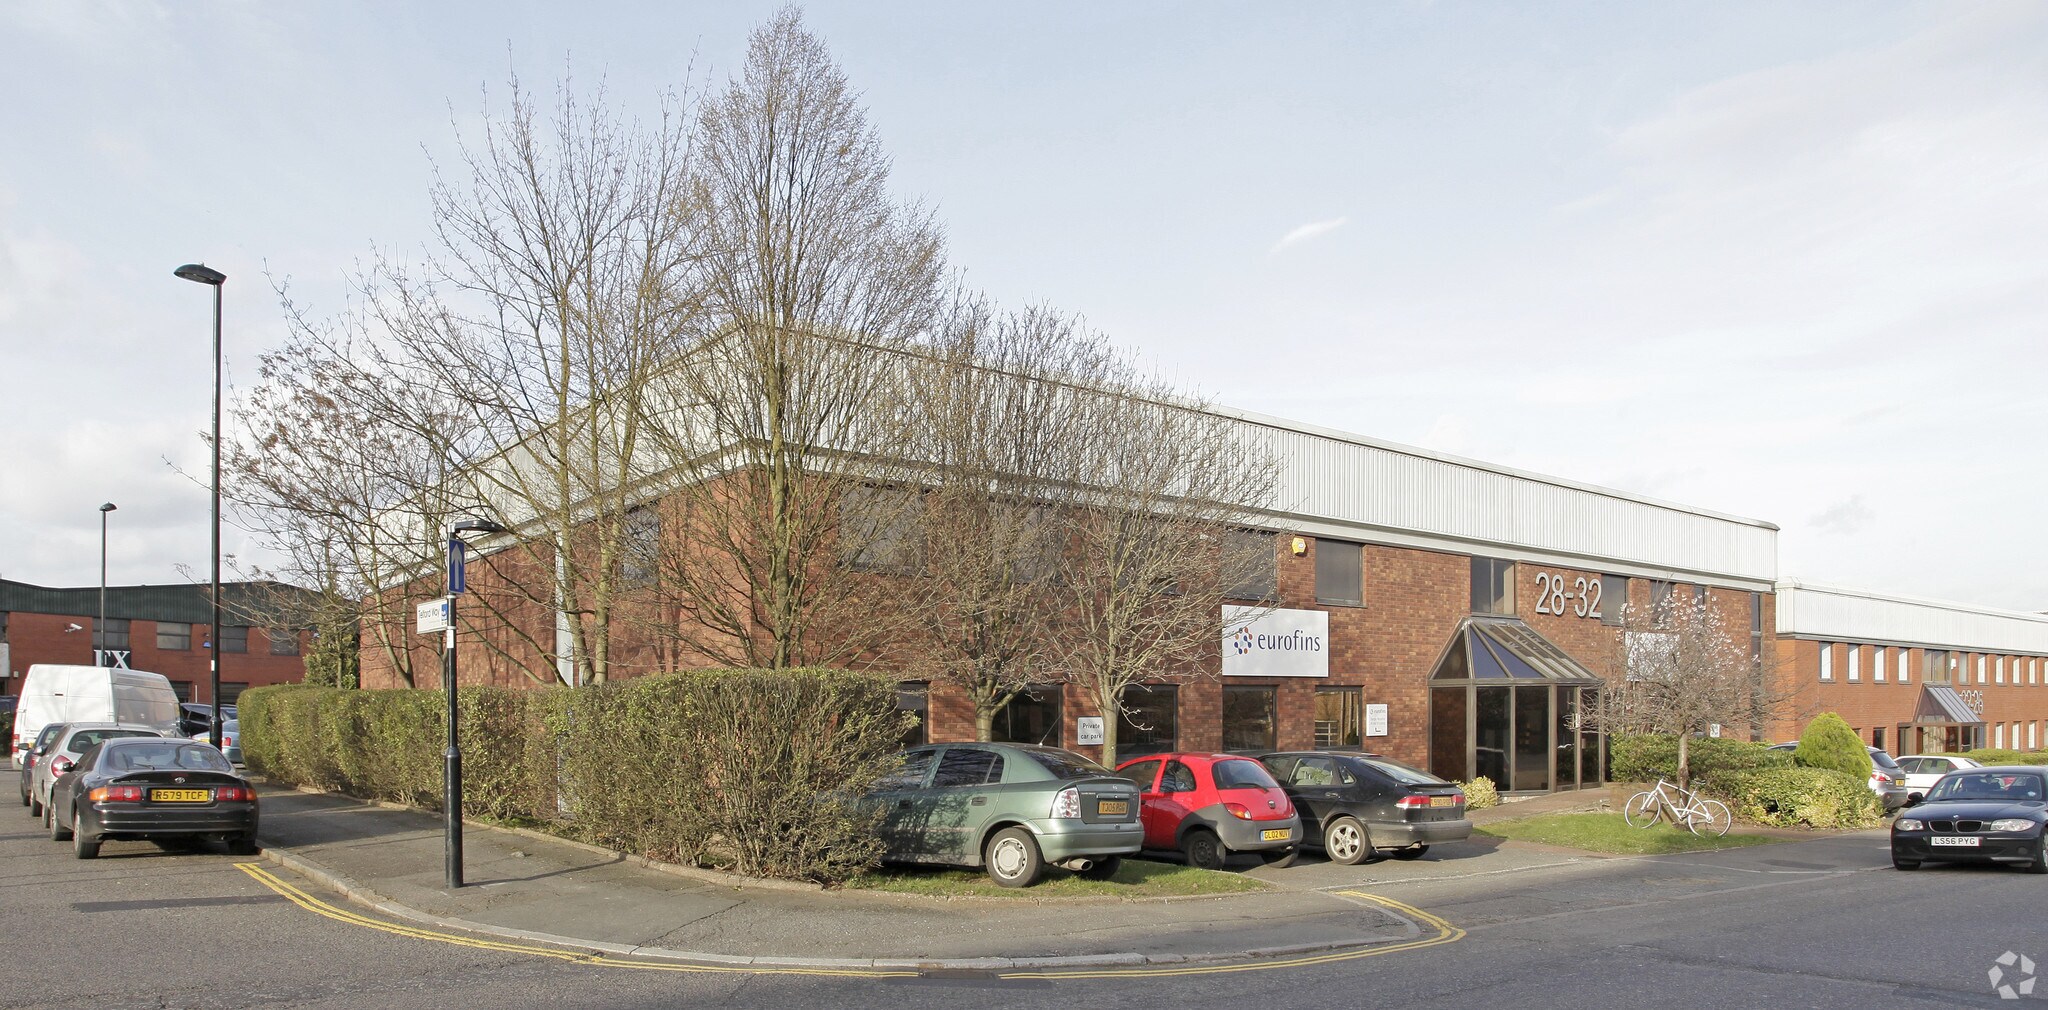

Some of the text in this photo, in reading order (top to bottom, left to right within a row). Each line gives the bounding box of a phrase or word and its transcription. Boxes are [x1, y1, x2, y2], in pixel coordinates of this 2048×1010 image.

[1535, 572, 1602, 617] 28-32
[1257, 629, 1321, 652] eurofins
[1090, 732, 1102, 740] park
[155, 791, 203, 800] R579 TCF
[1934, 837, 1975, 845] LS56 PYG
